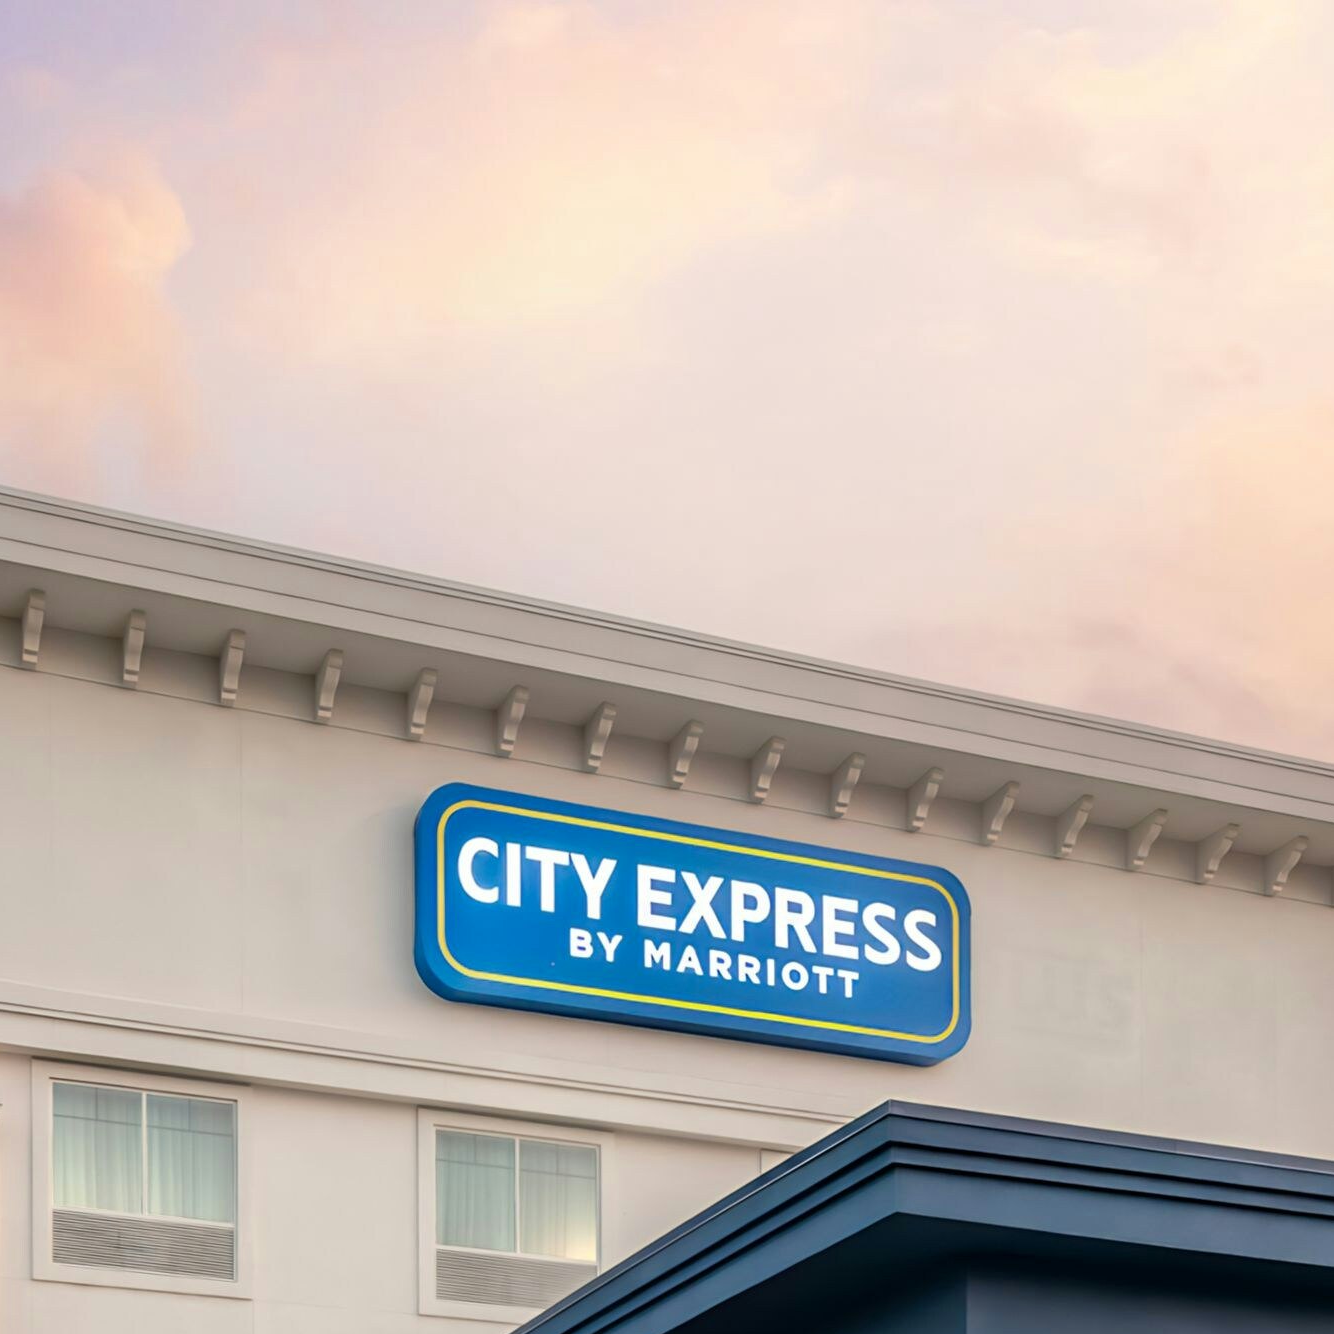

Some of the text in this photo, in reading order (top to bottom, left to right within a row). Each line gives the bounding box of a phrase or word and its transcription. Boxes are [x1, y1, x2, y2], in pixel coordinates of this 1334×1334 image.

[457, 836, 942, 972] CITY EXPRESS
[569, 927, 859, 998] BY MARRIOTT
